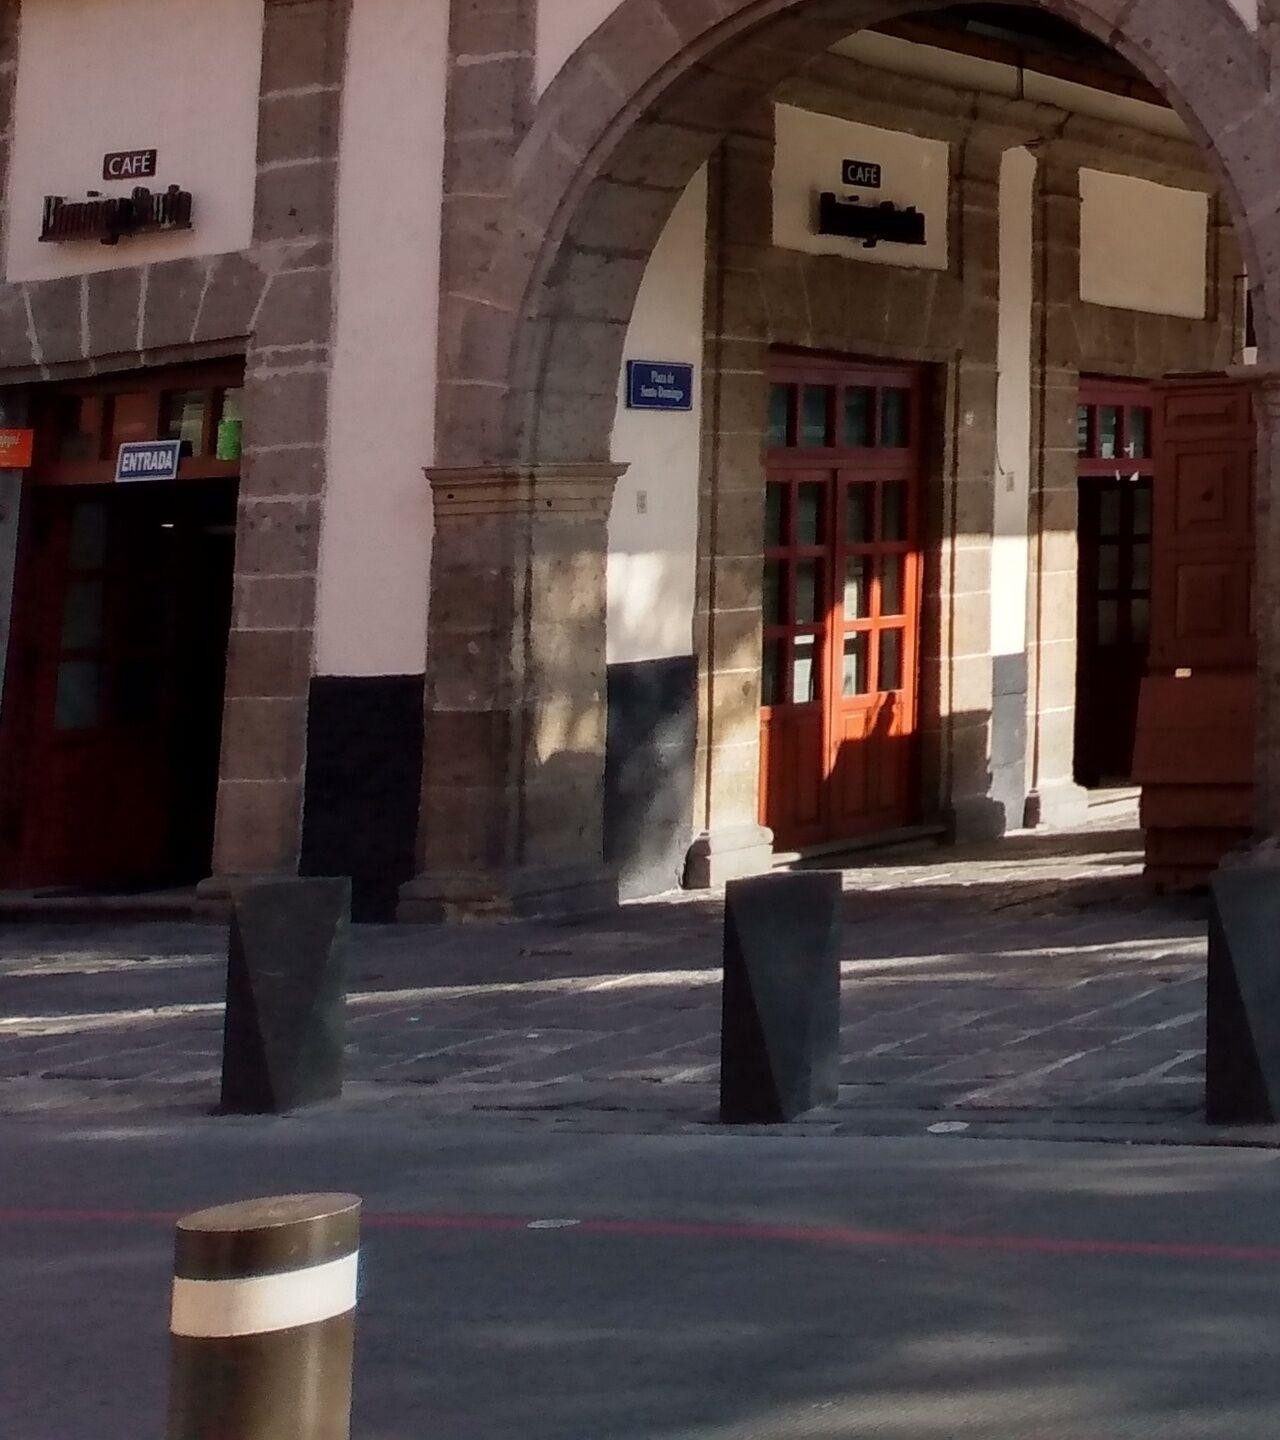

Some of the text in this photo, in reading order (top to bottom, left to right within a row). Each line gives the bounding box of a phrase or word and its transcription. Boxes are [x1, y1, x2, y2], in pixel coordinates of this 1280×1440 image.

[108, 151, 152, 176] CAFÉ
[847, 164, 878, 184] CAFÉ
[121, 450, 173, 472] ENTRADA
